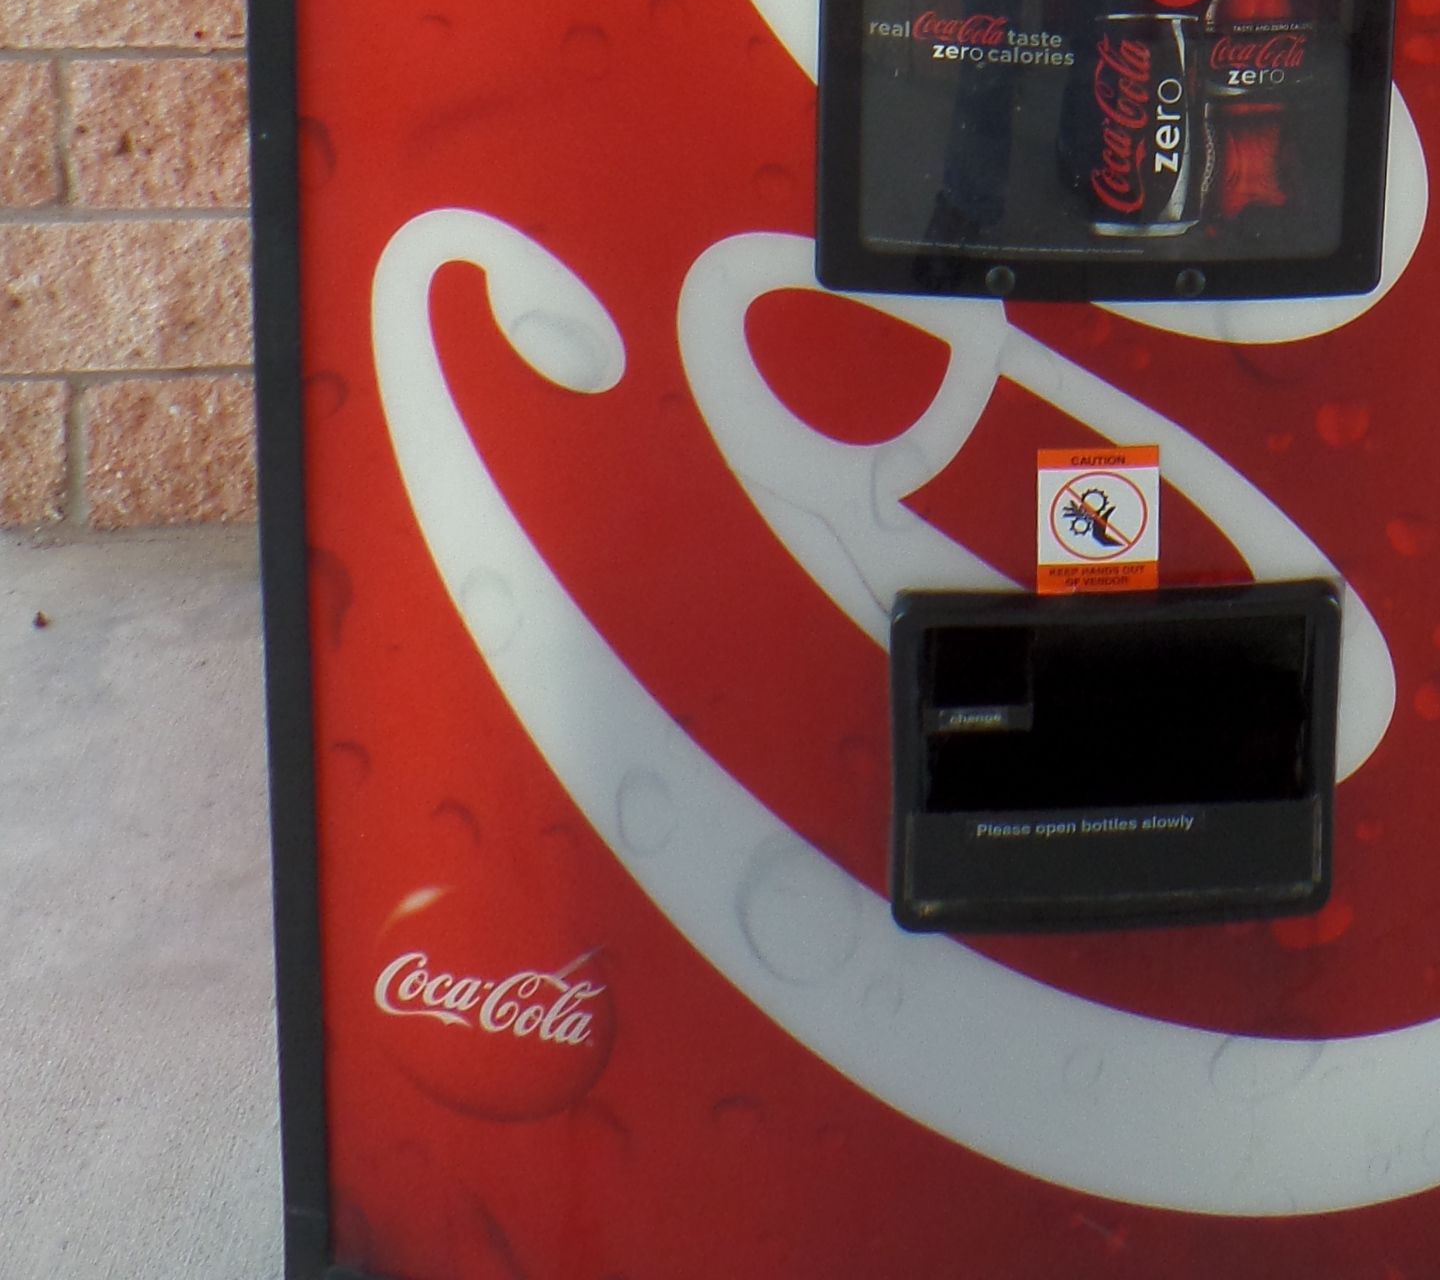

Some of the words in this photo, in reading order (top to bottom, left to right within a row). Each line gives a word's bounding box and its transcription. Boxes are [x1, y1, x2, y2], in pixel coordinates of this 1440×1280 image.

[869, 20, 911, 38] real
[912, 10, 1008, 47] Coca-Cola
[1007, 29, 1063, 48] taste
[932, 44, 984, 62] zero
[987, 47, 1075, 66] calories
[1227, 68, 1285, 86] zero
[1090, 31, 1152, 213] Coca-Cola
[1155, 78, 1184, 174] zero
[1071, 455, 1126, 466] CAUTION
[976, 822, 1032, 837] Please
[1035, 821, 1076, 838] open
[1081, 816, 1138, 832] bottles
[1142, 813, 1195, 831] slowly
[374, 951, 607, 1045] Coca-Cola
